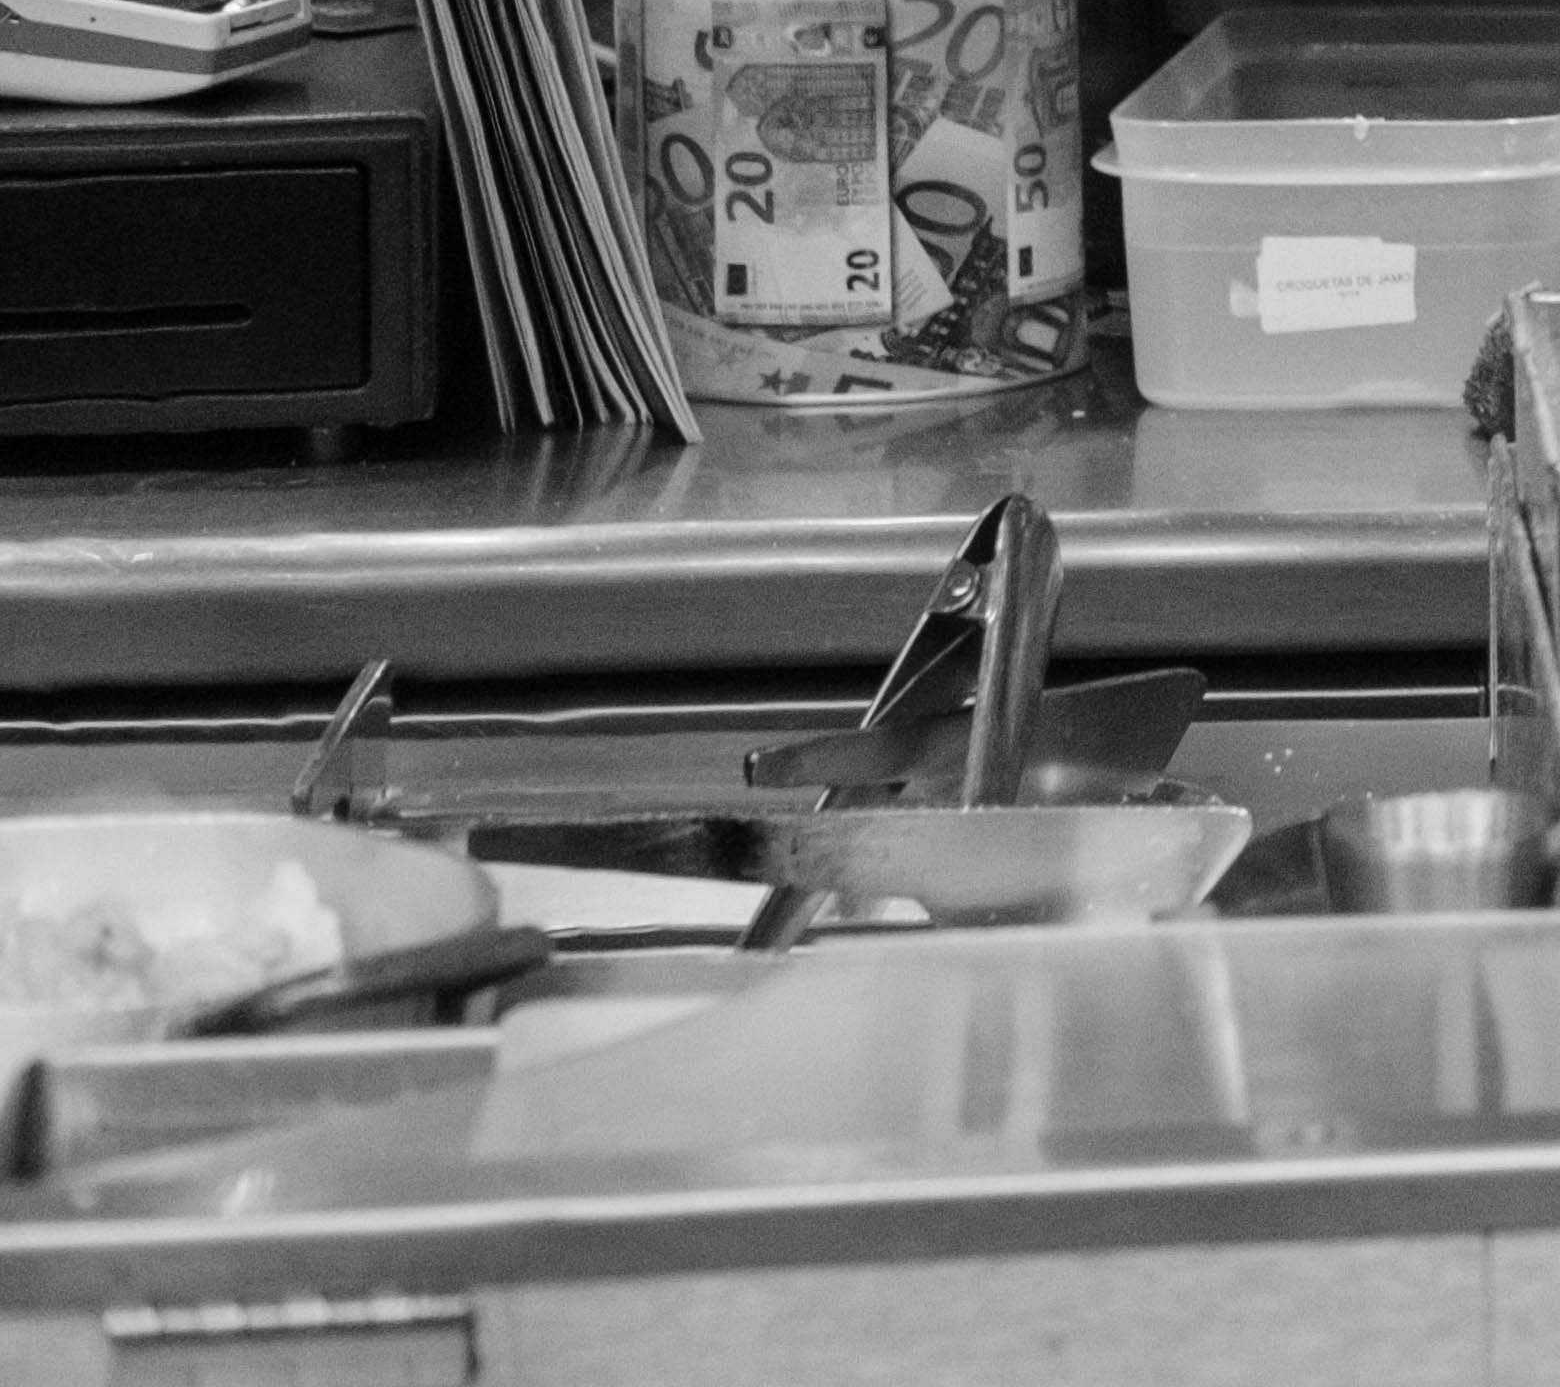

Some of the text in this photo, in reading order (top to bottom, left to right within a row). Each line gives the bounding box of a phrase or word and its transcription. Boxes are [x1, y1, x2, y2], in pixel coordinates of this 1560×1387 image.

[724, 152, 775, 225] 20
[1014, 143, 1049, 213] 50
[846, 249, 881, 294] 20
[1276, 276, 1354, 293] CROQUETAS
